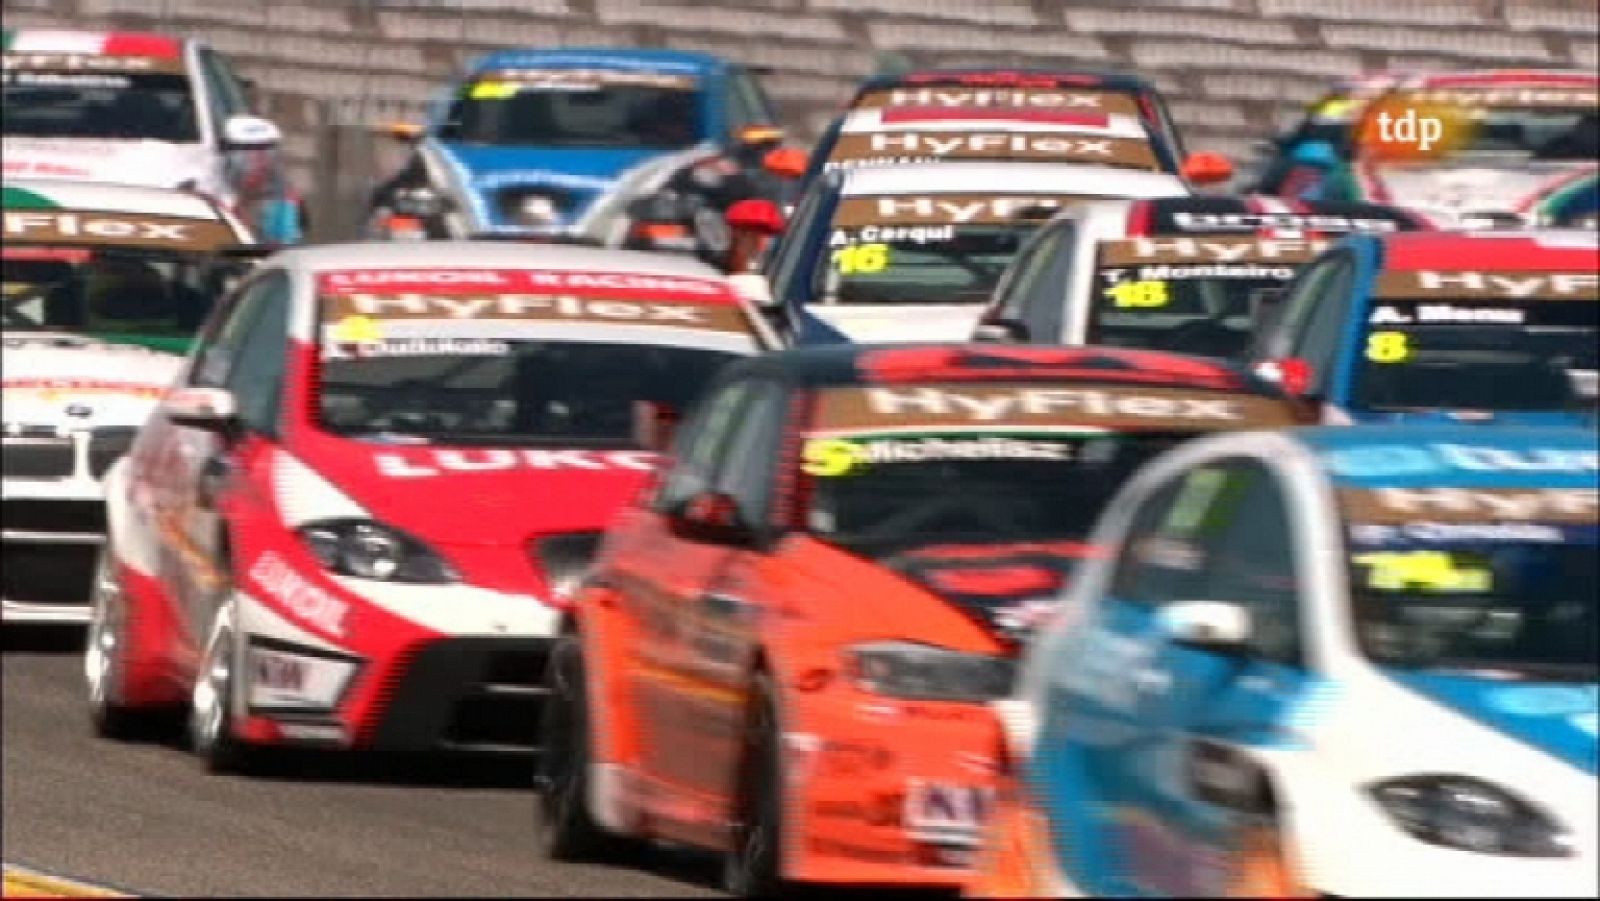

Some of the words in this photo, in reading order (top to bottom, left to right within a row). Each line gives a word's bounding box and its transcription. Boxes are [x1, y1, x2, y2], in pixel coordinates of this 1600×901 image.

[892, 88, 1101, 108] HyFlex
[870, 133, 1112, 155] HyFlex
[831, 244, 888, 274] 16
[326, 271, 508, 288] LUKOIL
[350, 291, 709, 322] HyFlex
[1367, 331, 1408, 364] 8
[862, 386, 1245, 421] HyFlex
